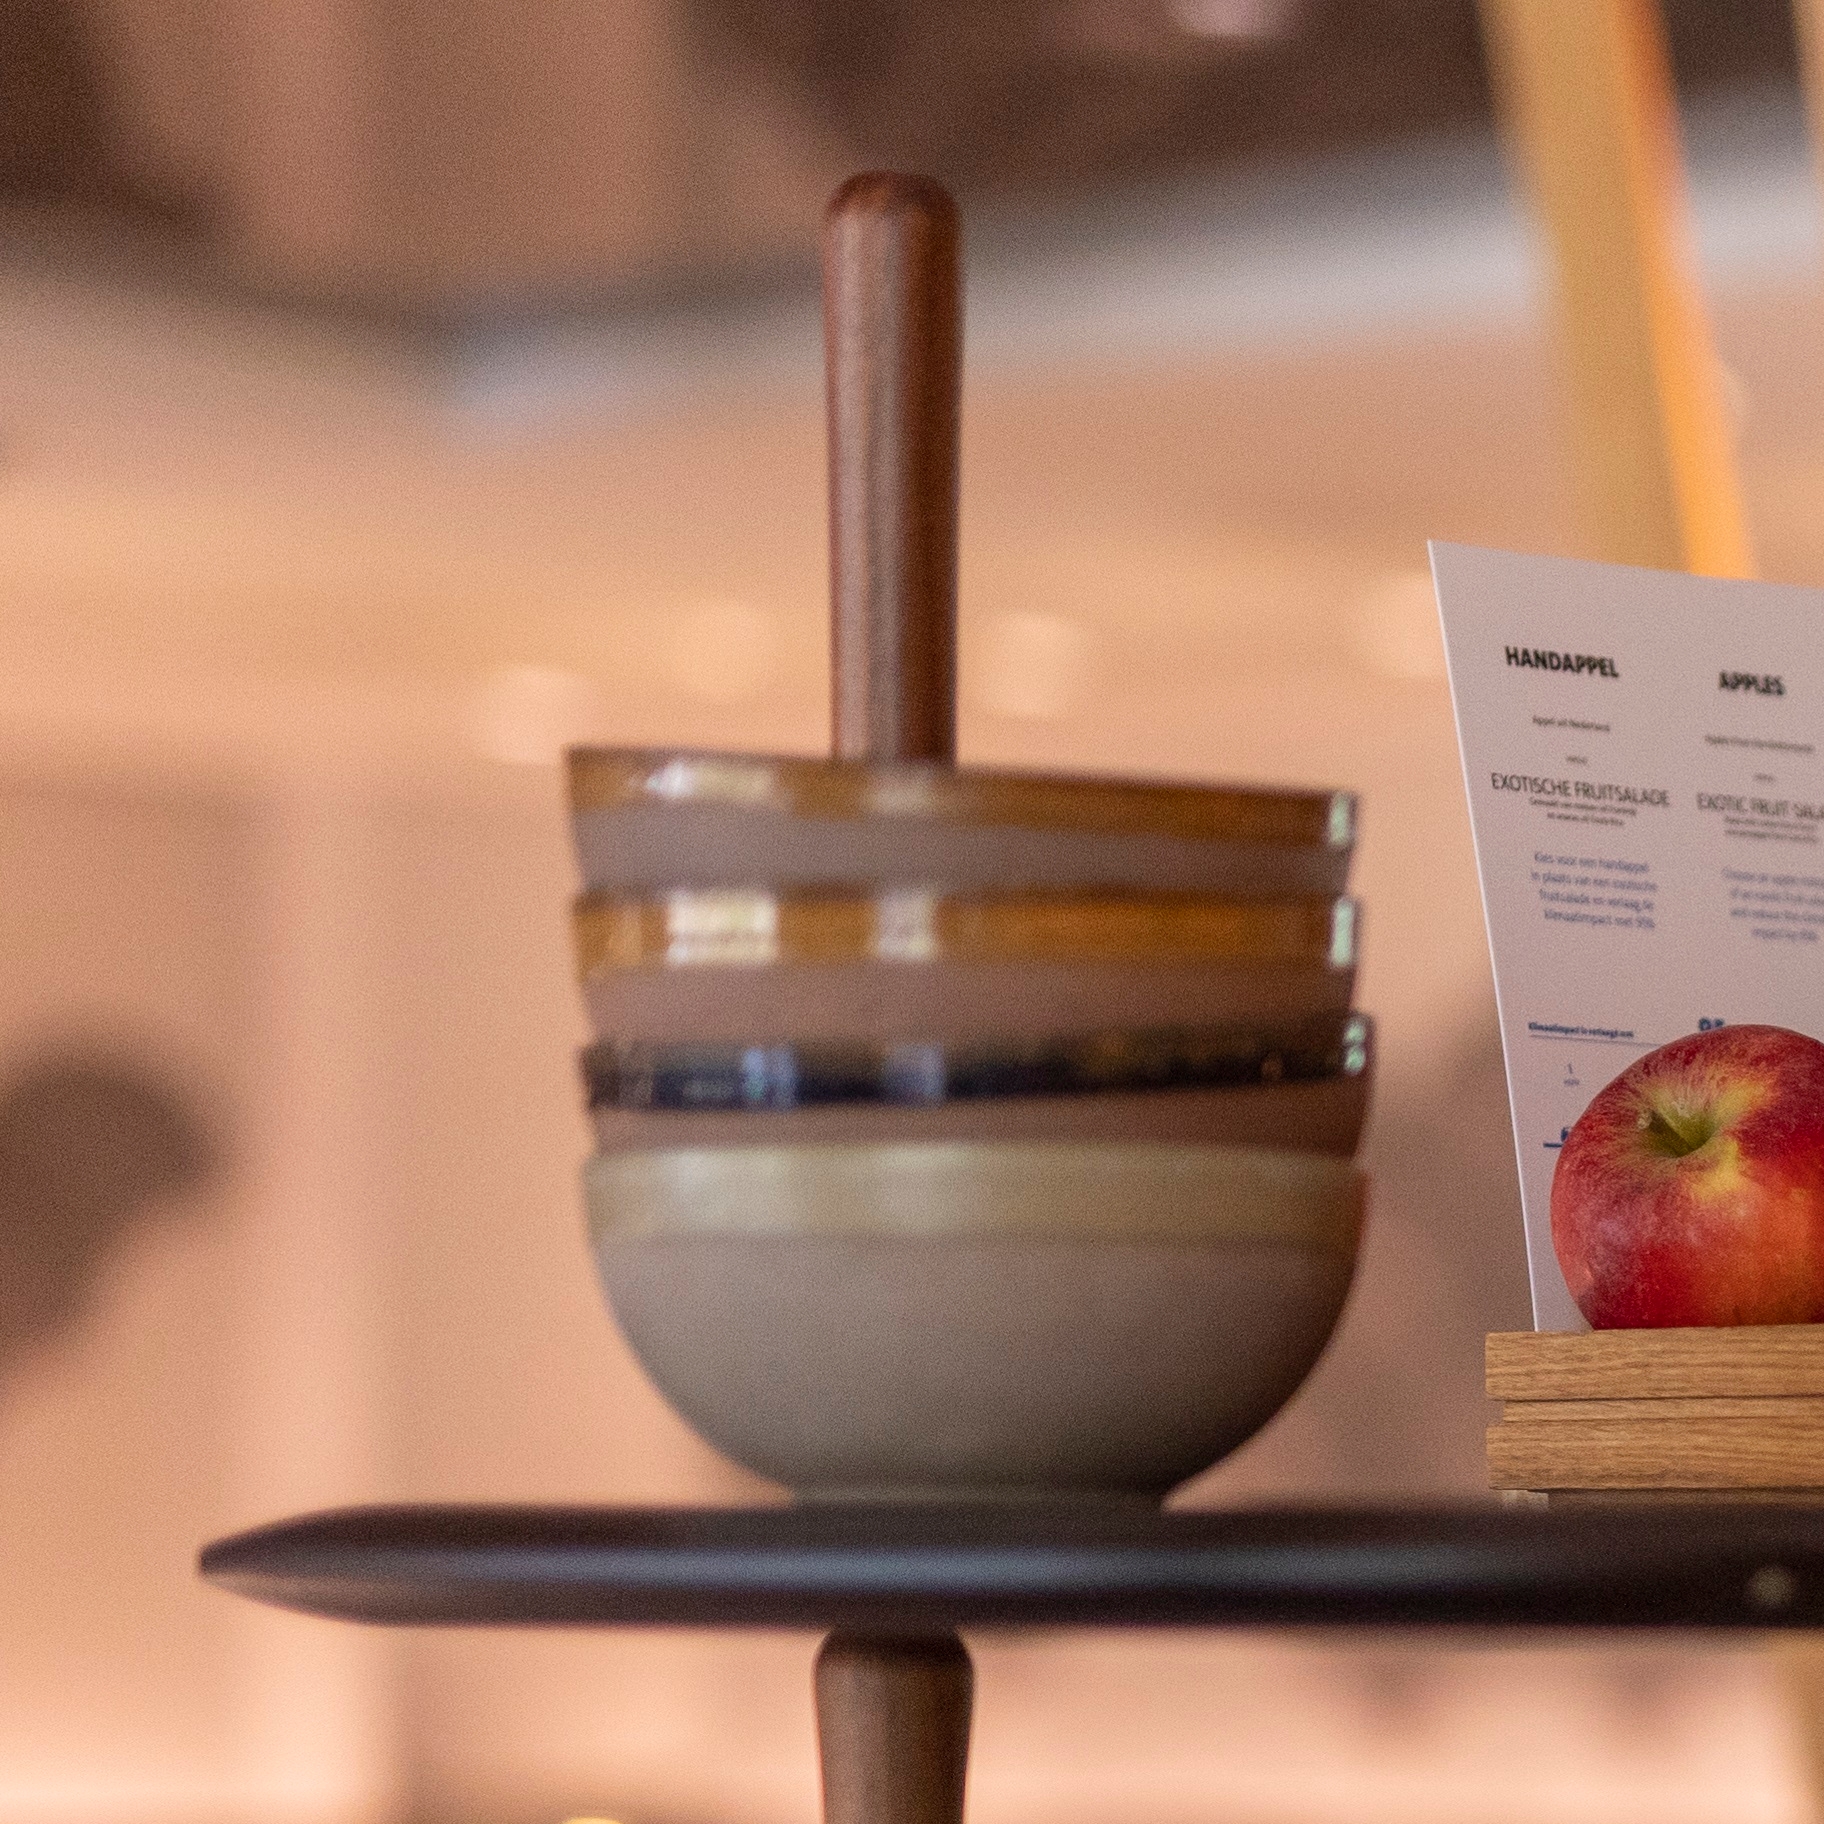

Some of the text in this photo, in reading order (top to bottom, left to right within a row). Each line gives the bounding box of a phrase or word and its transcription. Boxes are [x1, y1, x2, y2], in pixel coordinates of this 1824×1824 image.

[1505, 645, 1620, 678] HANDAPPEL
[1718, 670, 1787, 697] APPLES
[1491, 772, 1572, 798] EXOTISCHE
[1574, 779, 1671, 808] FRUITSALADE
